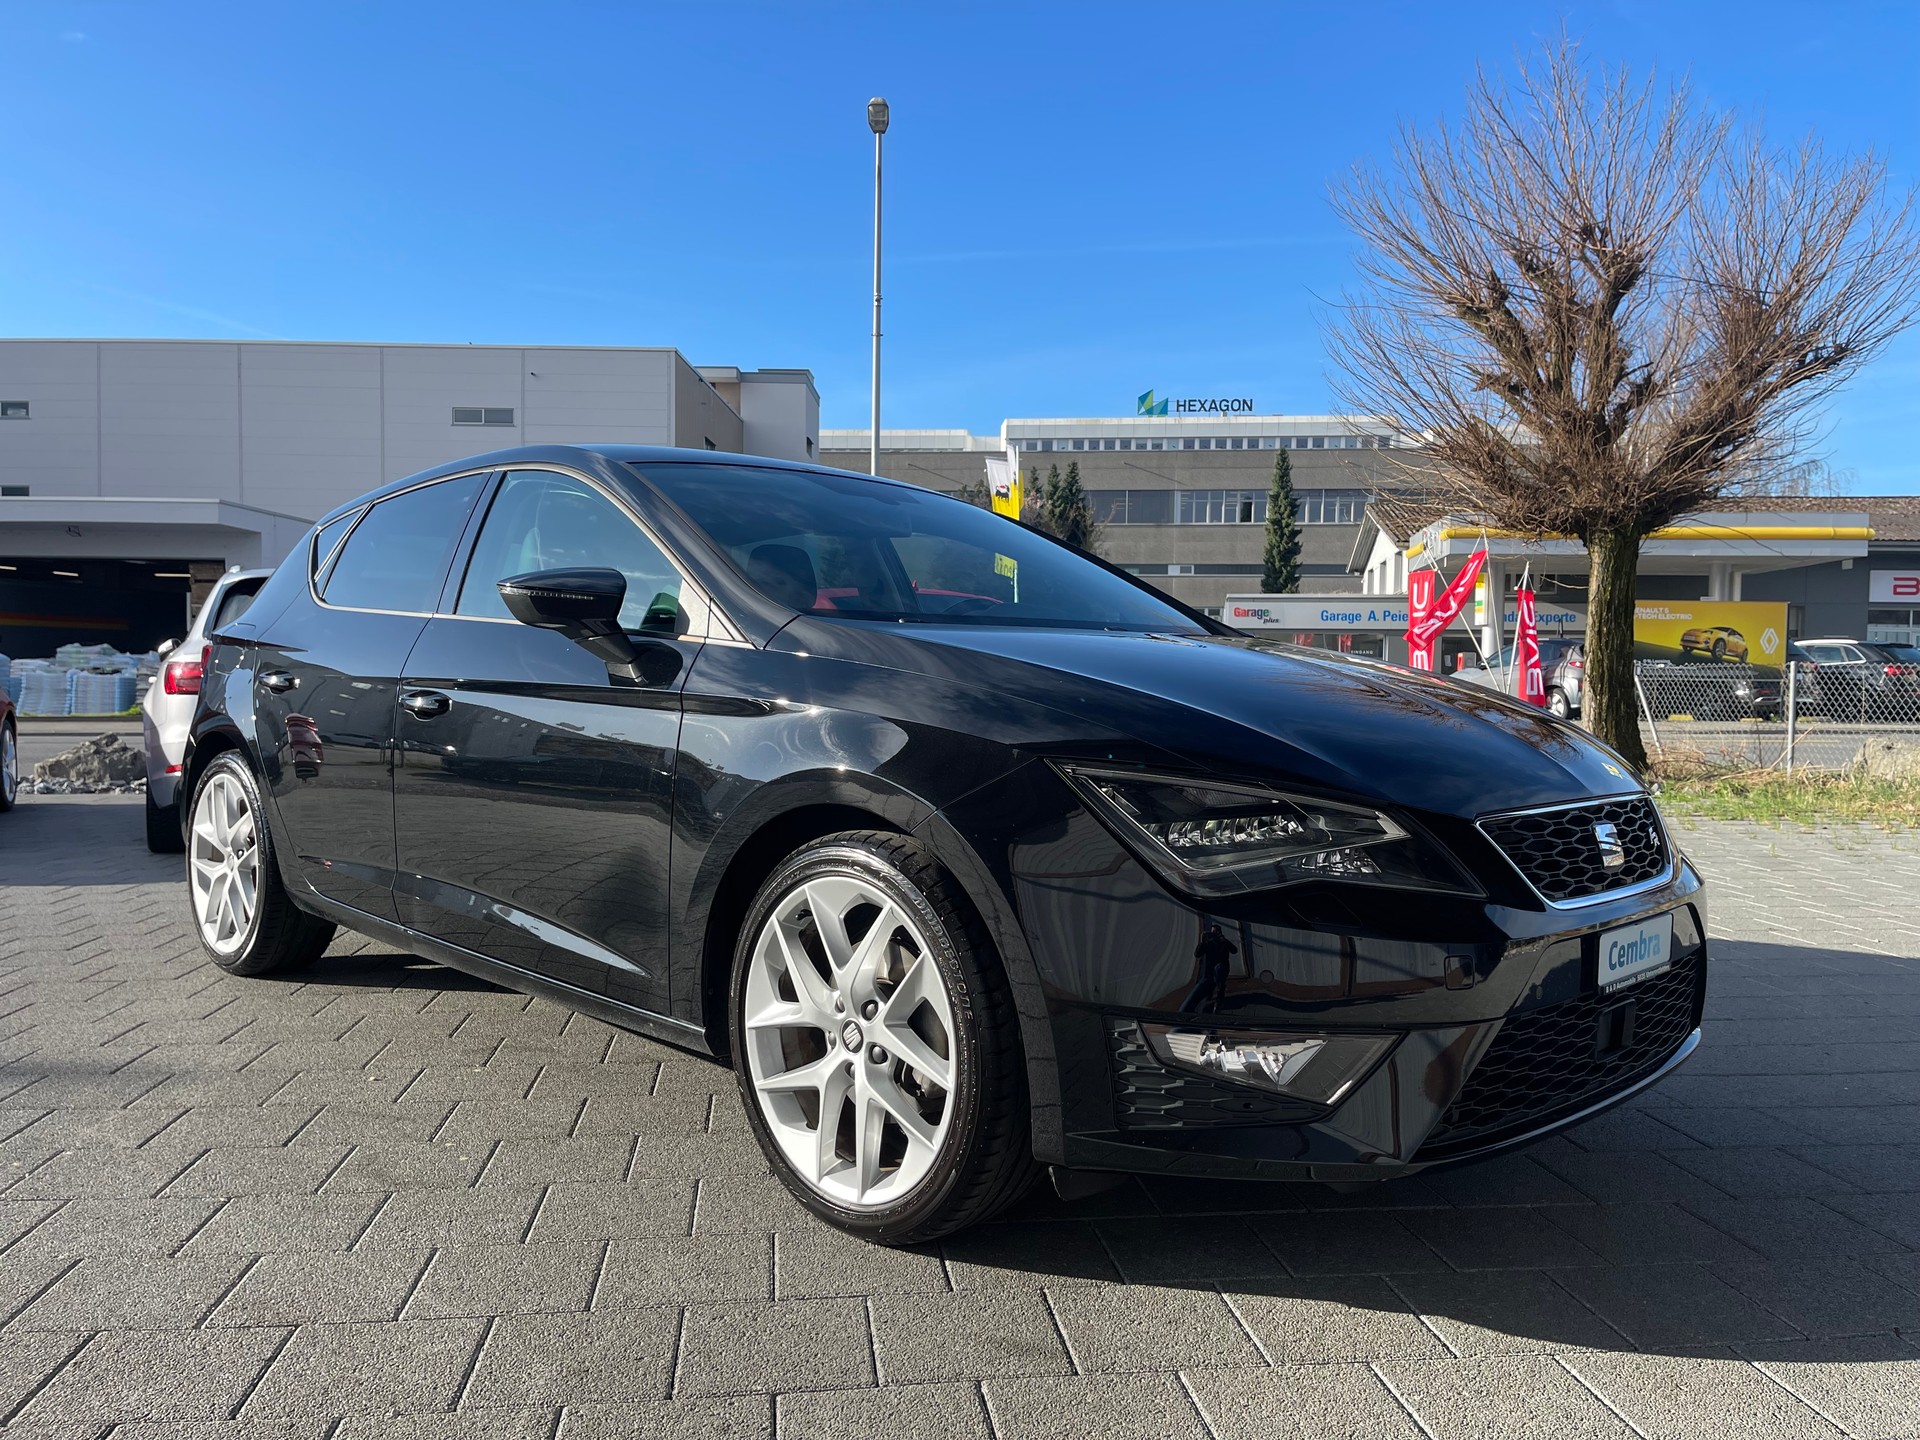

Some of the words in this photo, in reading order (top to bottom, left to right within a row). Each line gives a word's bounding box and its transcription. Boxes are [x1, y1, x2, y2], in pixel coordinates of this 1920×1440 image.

[1176, 399, 1253, 412] HEXAGON
[1234, 607, 1269, 619] Garage
[1321, 610, 1361, 624] Garage
[1368, 610, 1379, 621] A.
[1383, 610, 1408, 621] Peie
[1608, 930, 1660, 970] Cembra
